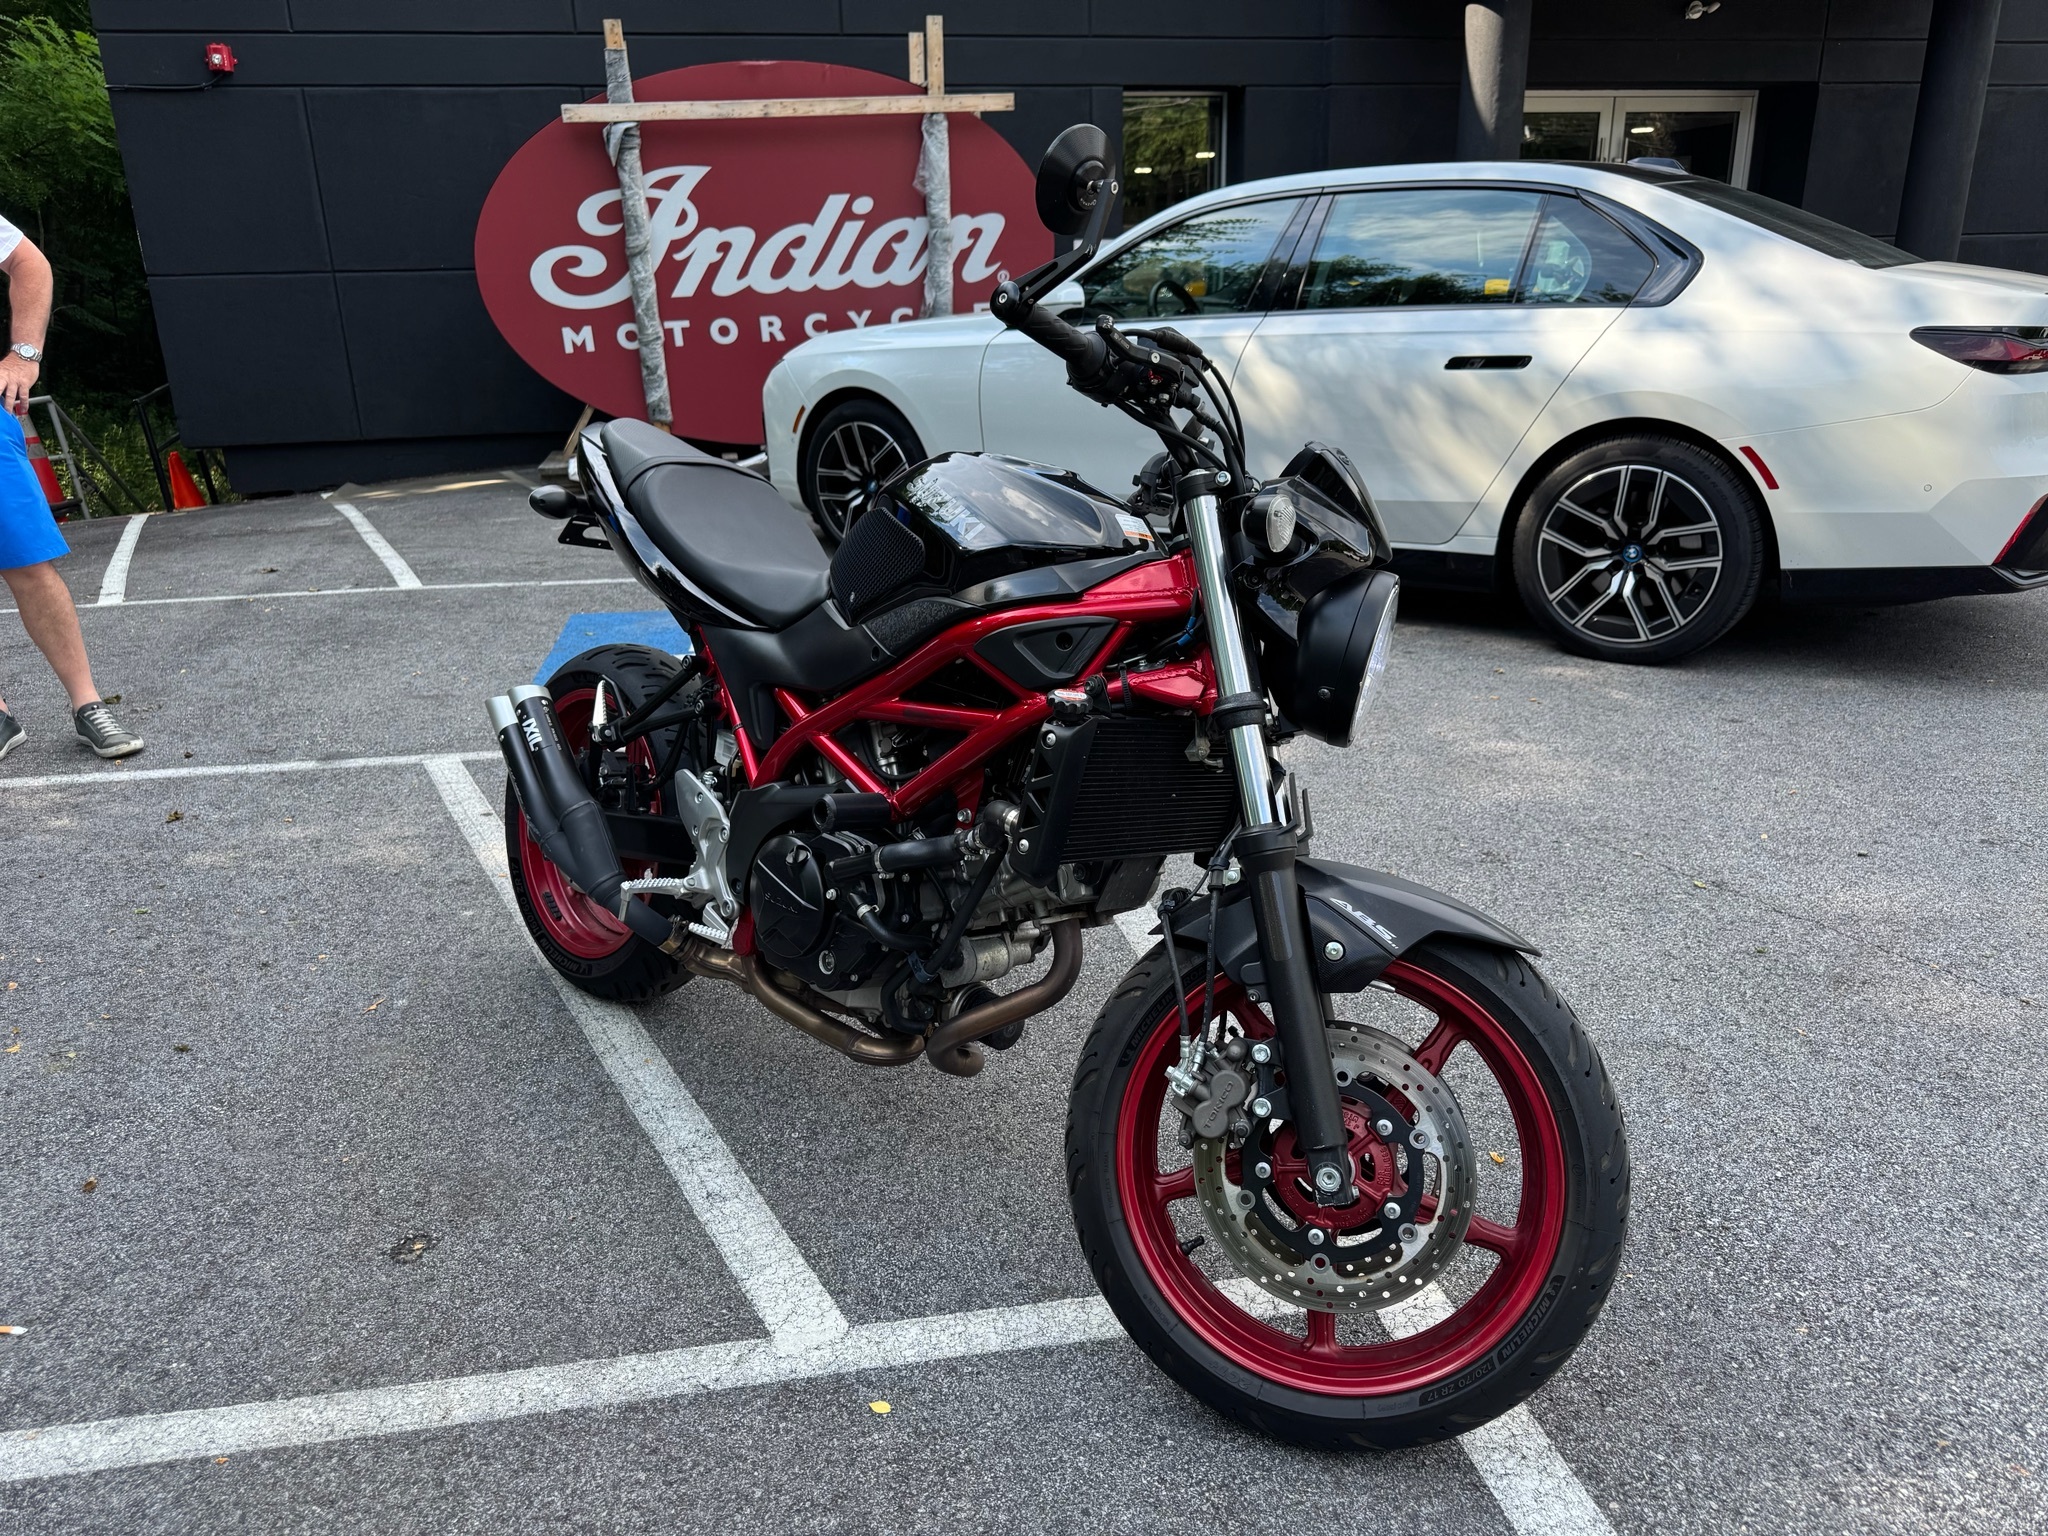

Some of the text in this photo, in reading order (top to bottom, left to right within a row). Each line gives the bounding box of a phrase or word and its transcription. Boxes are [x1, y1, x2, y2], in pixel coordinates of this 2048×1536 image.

[530, 165, 1005, 310] Indian
[906, 475, 986, 541] SUZUKI
[1328, 896, 1398, 948] ABS
[540, 937, 583, 974] MICHELIN
[1130, 990, 1177, 1049] MICHELIN
[1202, 1080, 1234, 1129] TOKICO
[1501, 1296, 1551, 1359] MICHELIN
[1427, 1360, 1494, 1402] 120/70 ZR 17
